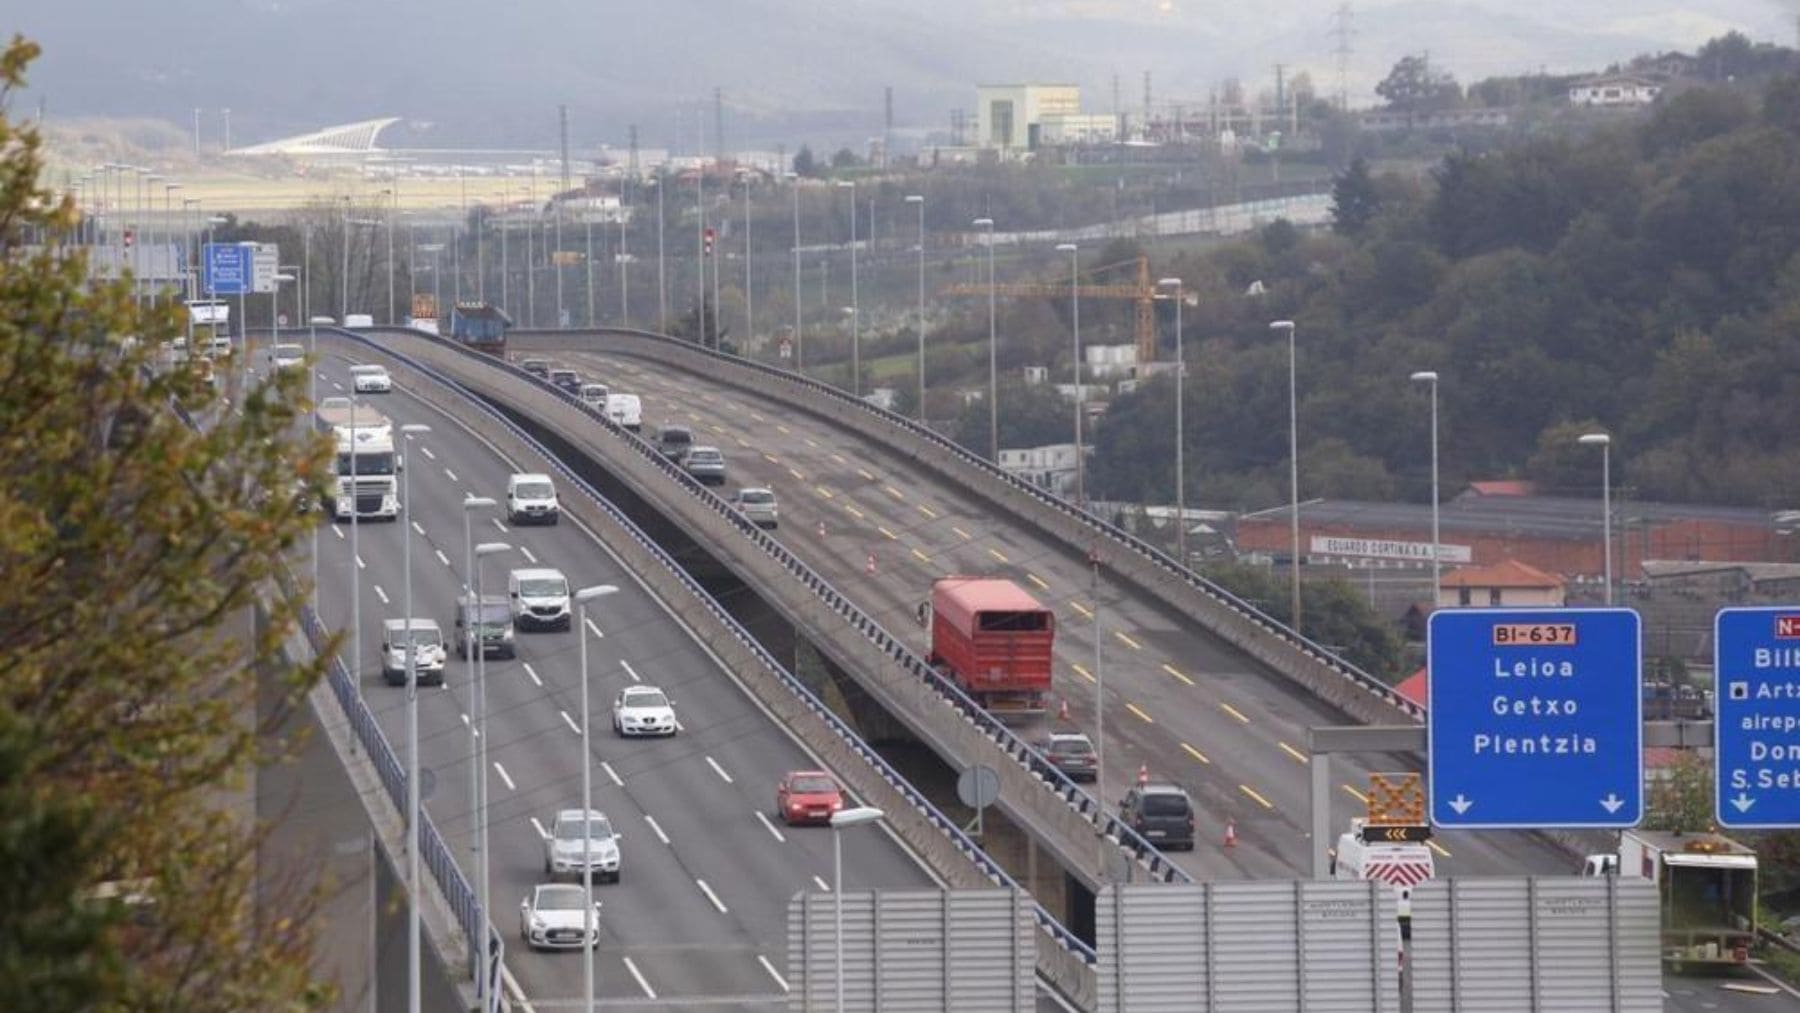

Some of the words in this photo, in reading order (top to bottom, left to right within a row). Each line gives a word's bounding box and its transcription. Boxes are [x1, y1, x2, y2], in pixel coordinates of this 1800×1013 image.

[1496, 626, 1572, 642] BI-637
[1495, 658, 1573, 677] Leioa
[1493, 696, 1577, 715] Getxo
[1742, 714, 1800, 732] airep
[1474, 734, 1596, 753] Plentzia
